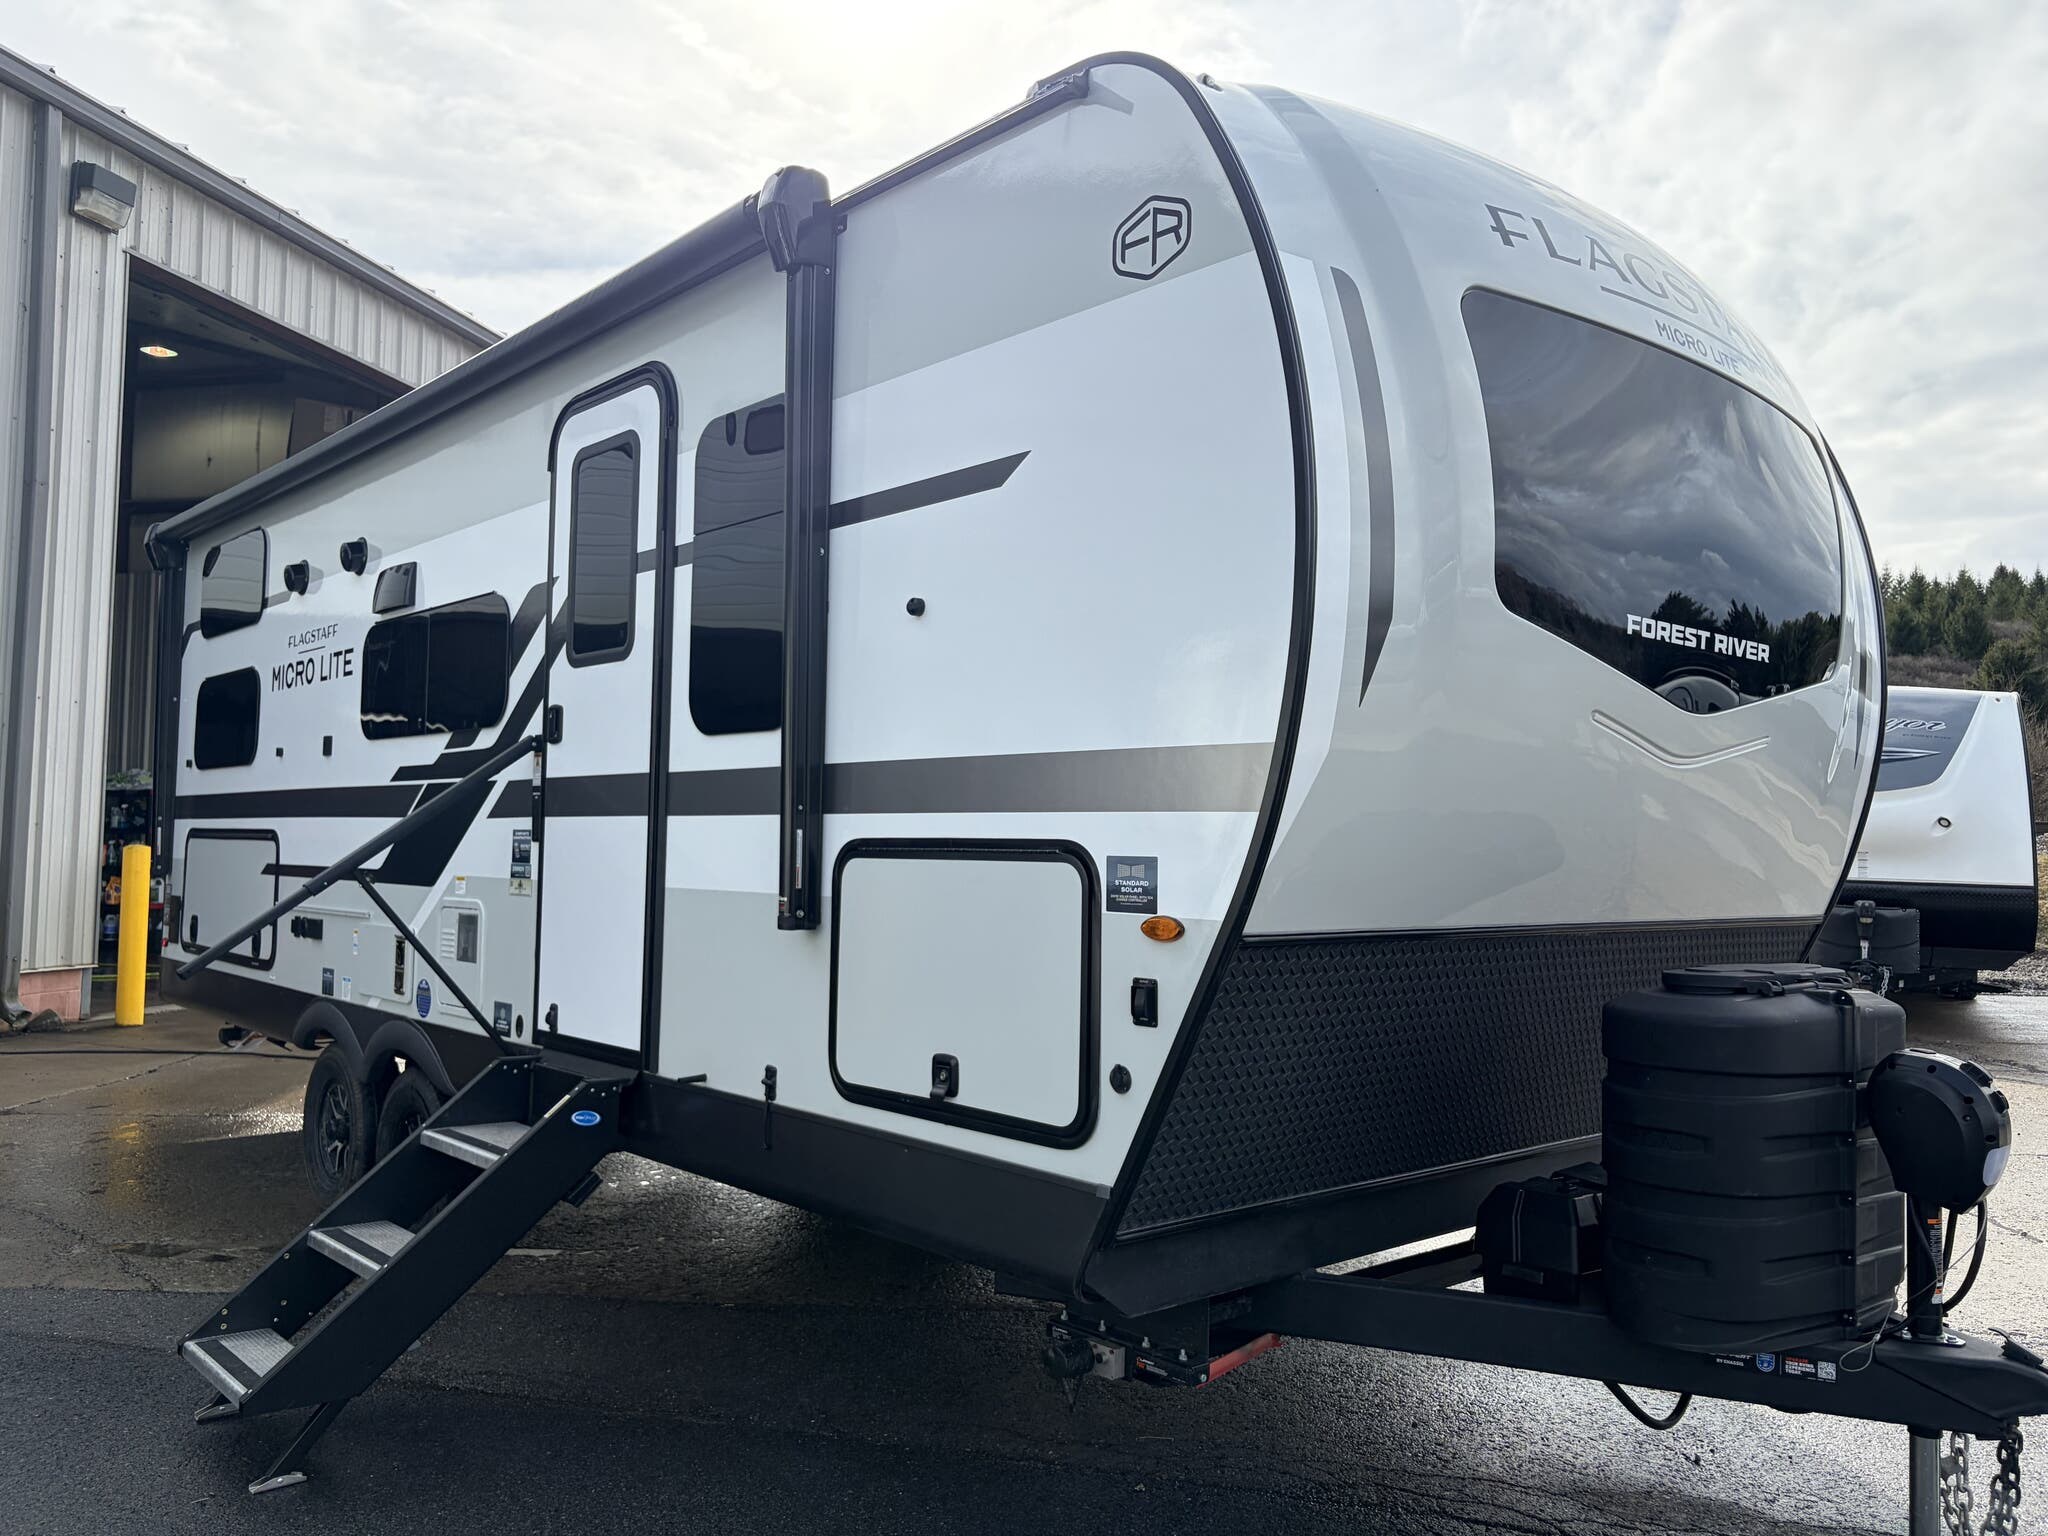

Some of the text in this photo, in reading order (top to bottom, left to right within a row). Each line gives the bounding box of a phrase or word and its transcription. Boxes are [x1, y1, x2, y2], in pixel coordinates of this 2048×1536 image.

[1485, 203, 1775, 371] FLAGSTA
[1655, 319, 1743, 378] MICRO LITE
[288, 623, 339, 649] FLAGSTAFF
[1626, 613, 1770, 663] FOREST RIVER
[271, 647, 355, 693] MICRO LITE
[1785, 1365, 1816, 1373] EXPERIENCE
